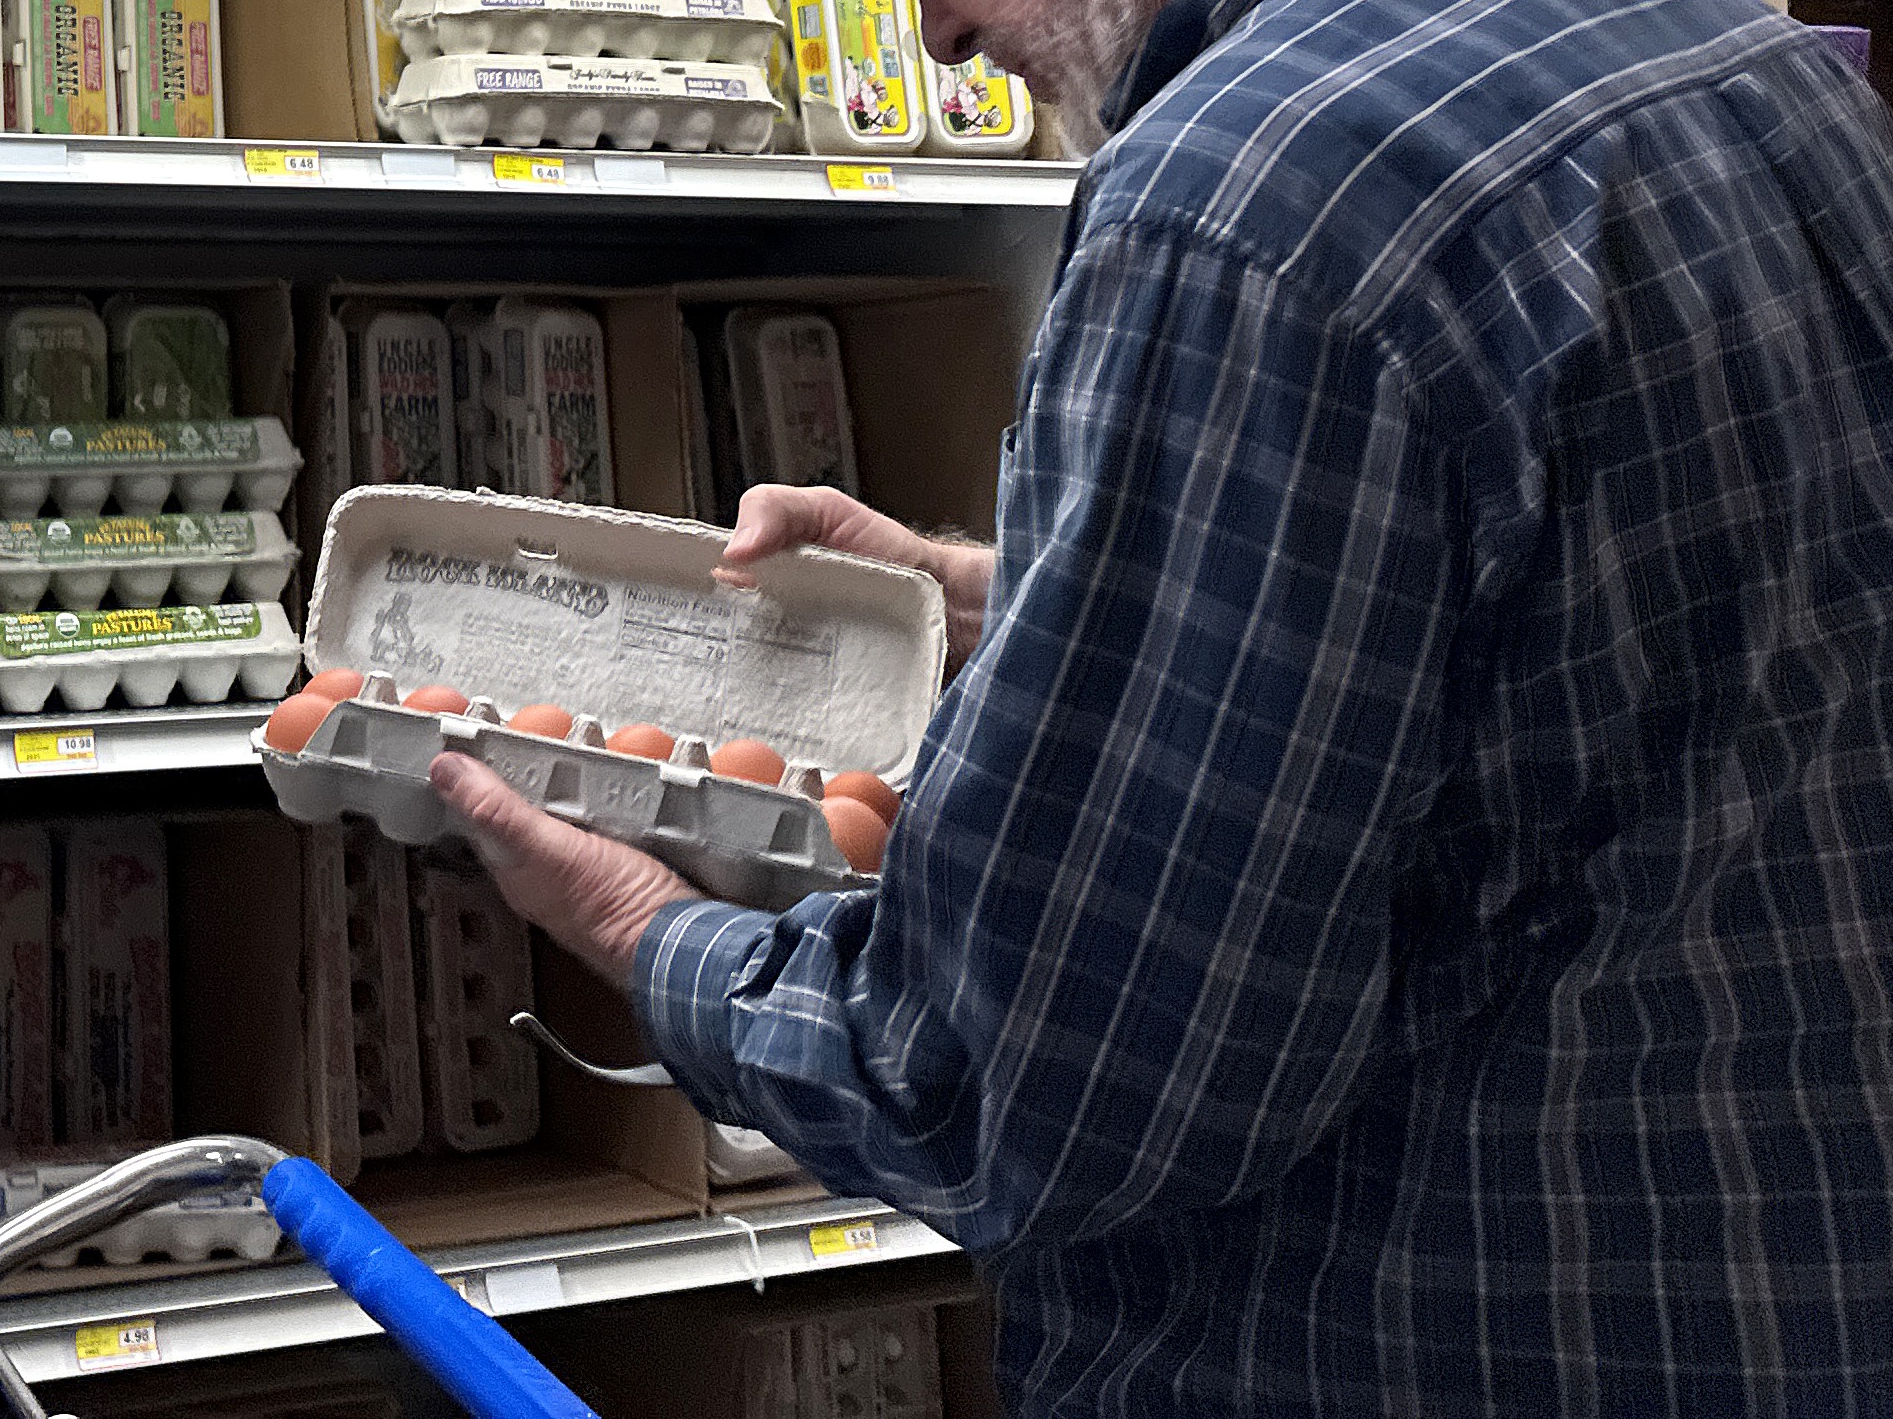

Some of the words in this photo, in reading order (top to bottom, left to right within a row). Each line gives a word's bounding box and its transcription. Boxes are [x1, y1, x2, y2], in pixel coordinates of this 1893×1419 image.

[55, 5, 78, 97] ORGANIC
[161, 11, 185, 102] ORGANIC
[476, 71, 503, 88] FREE
[505, 71, 542, 89] RANGE
[381, 395, 439, 416] FARM
[547, 392, 596, 416] FARM
[86, 440, 166, 453] PASTURES
[84, 532, 165, 545] PASTURES
[92, 614, 173, 635] PASTURES
[706, 646, 725, 660] 70
[65, 738, 91, 749] 10.98
